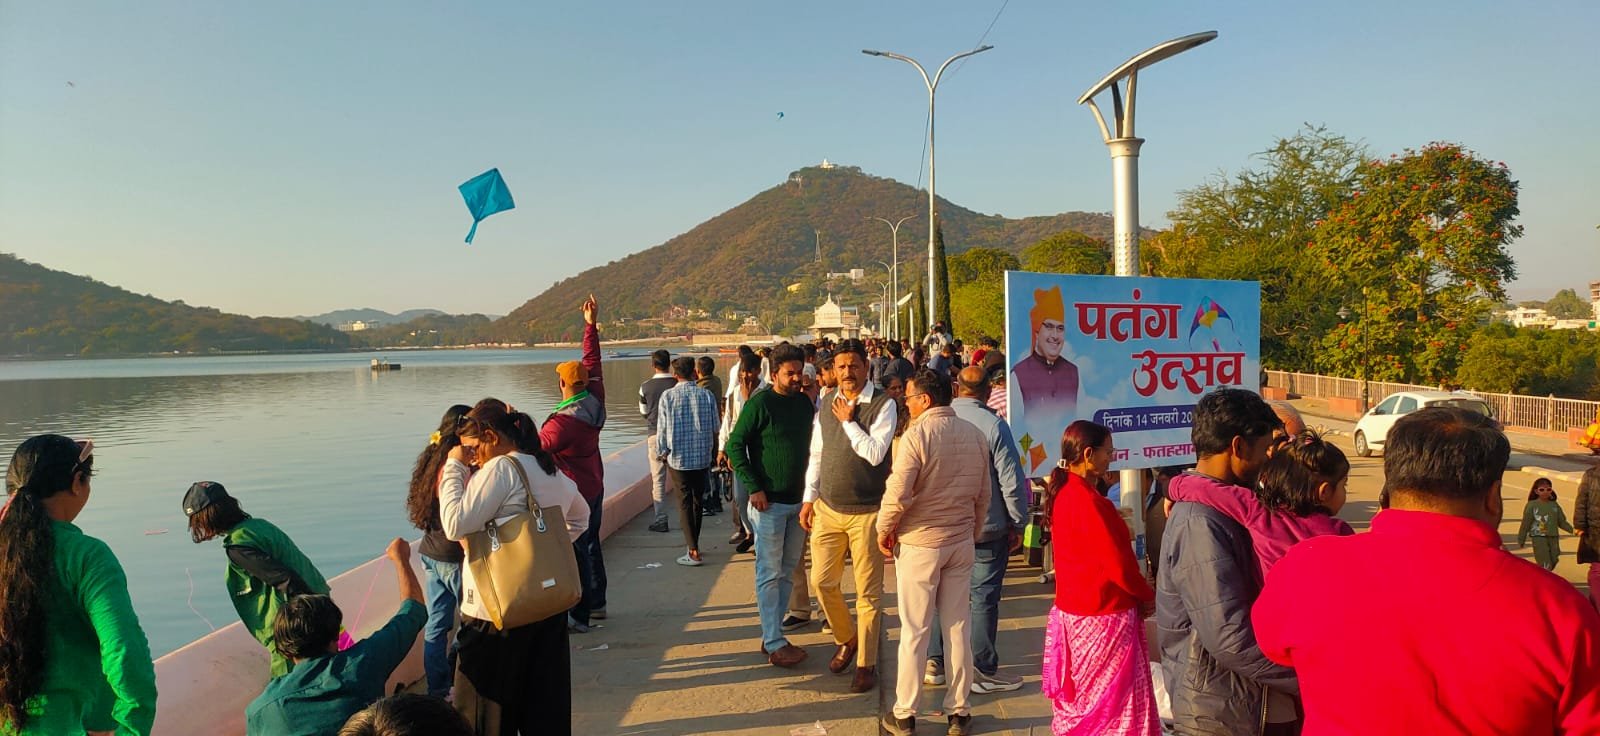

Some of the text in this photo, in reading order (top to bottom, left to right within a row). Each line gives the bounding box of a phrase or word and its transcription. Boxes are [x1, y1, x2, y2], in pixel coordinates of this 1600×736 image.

[1074, 288, 1182, 342] पतंग
[1131, 350, 1246, 397] उत्सव
[1103, 411, 1133, 430] दिनांक
[1136, 414, 1147, 426] 14
[1150, 407, 1179, 425] जनवरी
